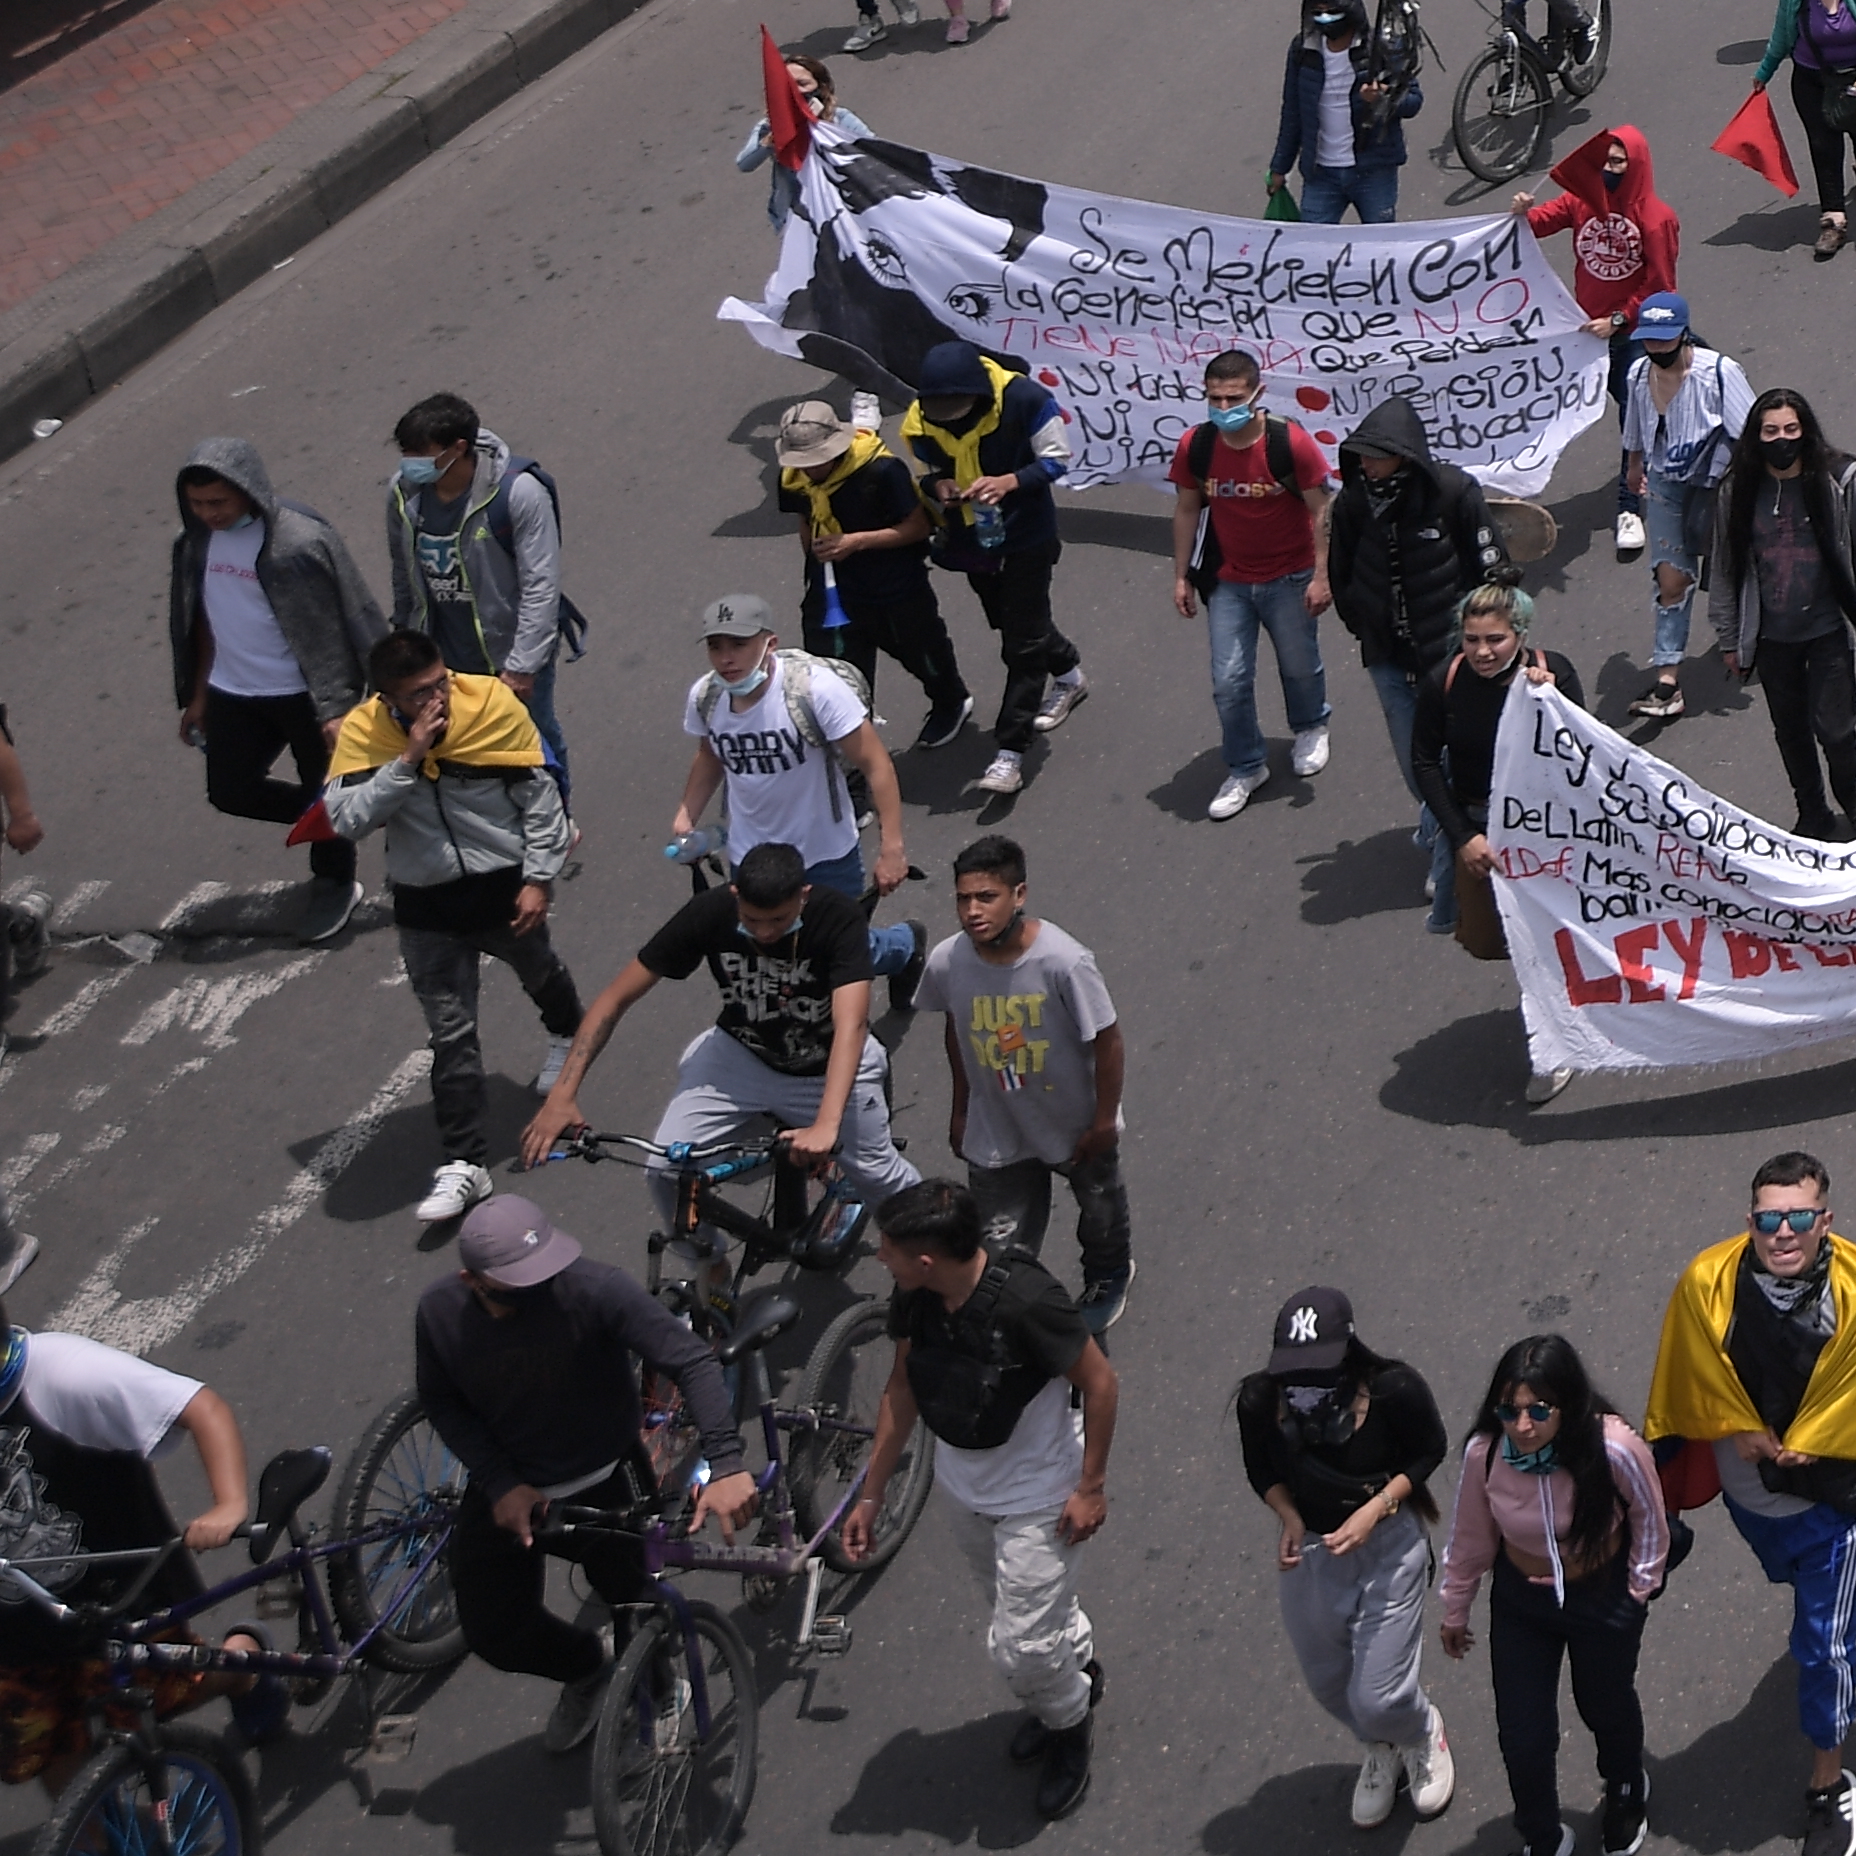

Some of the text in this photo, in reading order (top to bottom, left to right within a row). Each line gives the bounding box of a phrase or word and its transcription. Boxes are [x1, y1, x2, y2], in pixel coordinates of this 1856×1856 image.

[1068, 206, 1155, 282] Se
[717, 601, 736, 624] LA
[1533, 707, 1594, 787] Ley
[1553, 917, 1708, 1010] LEY
[970, 992, 1049, 1033] JUST
[1287, 1305, 1320, 1343] NY
